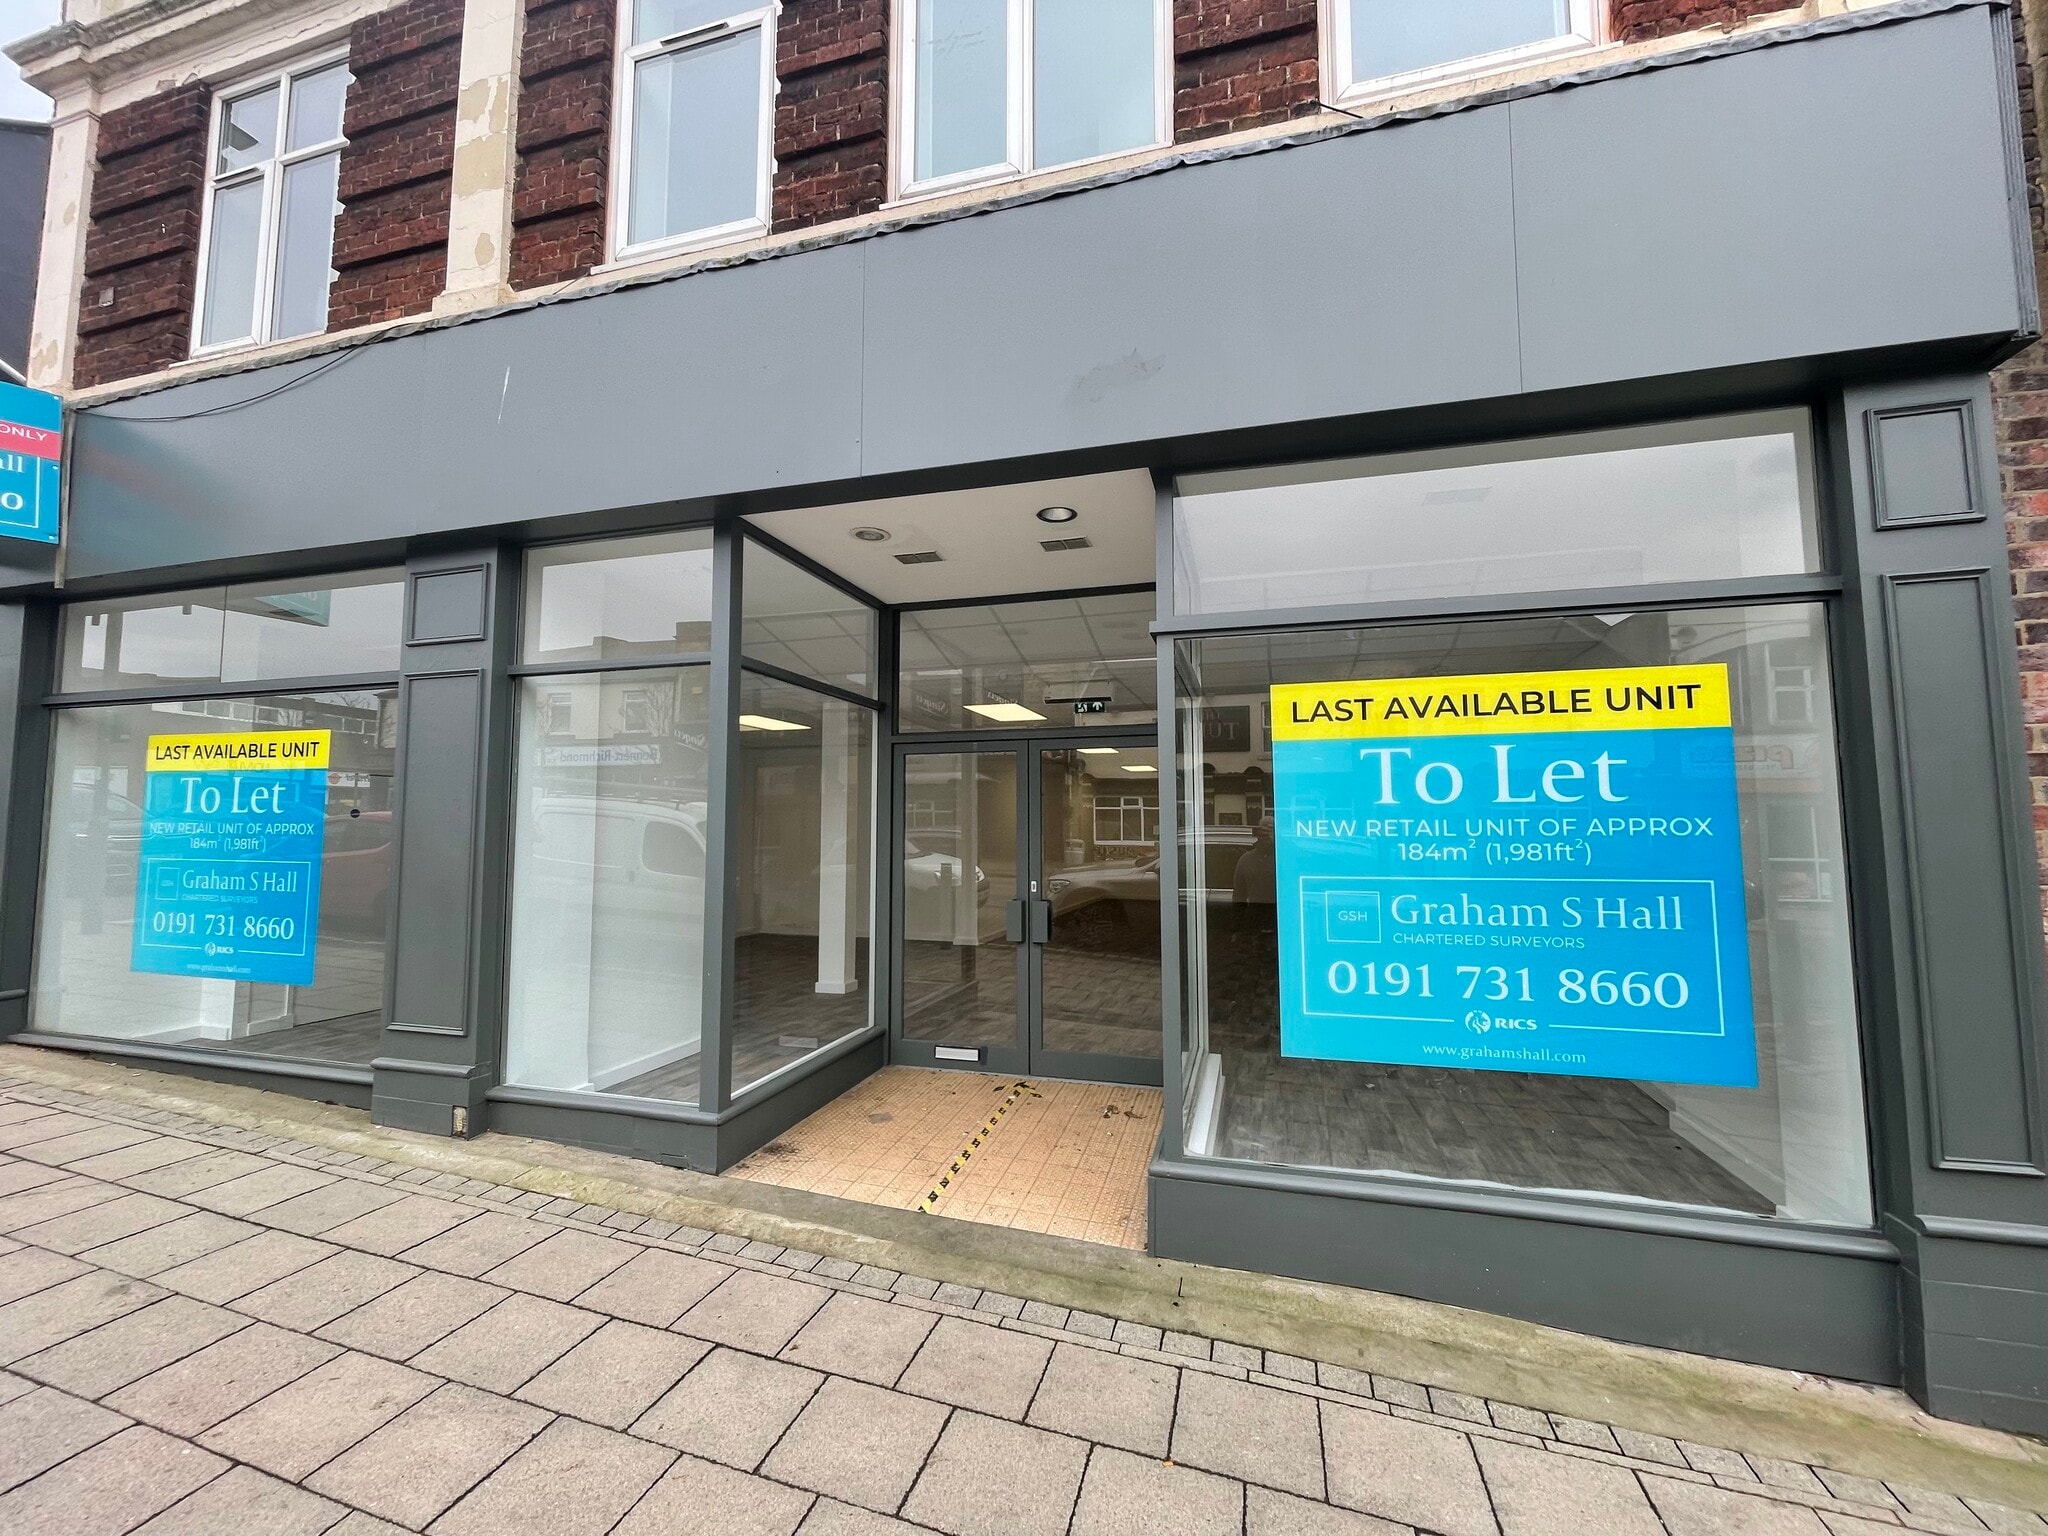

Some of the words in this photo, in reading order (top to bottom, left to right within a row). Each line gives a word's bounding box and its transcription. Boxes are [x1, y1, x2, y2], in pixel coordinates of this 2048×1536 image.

[0, 423, 48, 441] ONLY
[1292, 698, 1374, 723] LAST
[1384, 688, 1593, 720] AVAILABLE
[1606, 684, 1702, 711] UNIT
[156, 745, 190, 760] LAST
[193, 742, 277, 760] AVAILABLE
[282, 741, 320, 757] UNIT
[1361, 747, 1465, 805] To
[1490, 744, 1630, 803] Let
[180, 776, 221, 814] To
[230, 776, 287, 814] Let
[150, 823, 175, 834] NEW
[178, 823, 213, 835] RETAIL
[217, 823, 243, 834] UNIT
[246, 823, 262, 834] OF
[264, 823, 314, 835] APPROX
[1296, 820, 1357, 837] NEW
[1367, 819, 1456, 837] RETAIL
[1465, 818, 1530, 837] UNIT
[1538, 818, 1578, 837] OF
[1586, 817, 1714, 837] APPROX
[1398, 839, 1477, 862] 184m²
[183, 869, 245, 891] Graham
[250, 872, 260, 891] S
[262, 871, 297, 893] Hall
[1338, 910, 1368, 922] GSH
[1391, 893, 1549, 928] Graham
[1562, 896, 1583, 929] S
[1596, 895, 1686, 931] Hall
[153, 911, 196, 934] 0191
[204, 914, 236, 937] 731
[243, 916, 295, 940] 8660
[1393, 932, 1486, 947] CHARTERED
[1490, 934, 1585, 949] SURVEYORS
[1328, 959, 1435, 998] 0191
[1456, 965, 1536, 1002] 731
[1558, 968, 1689, 1009] 8660
[1495, 1018, 1538, 1031] RICS
[1422, 1043, 1586, 1064] www.grahamshall.com
